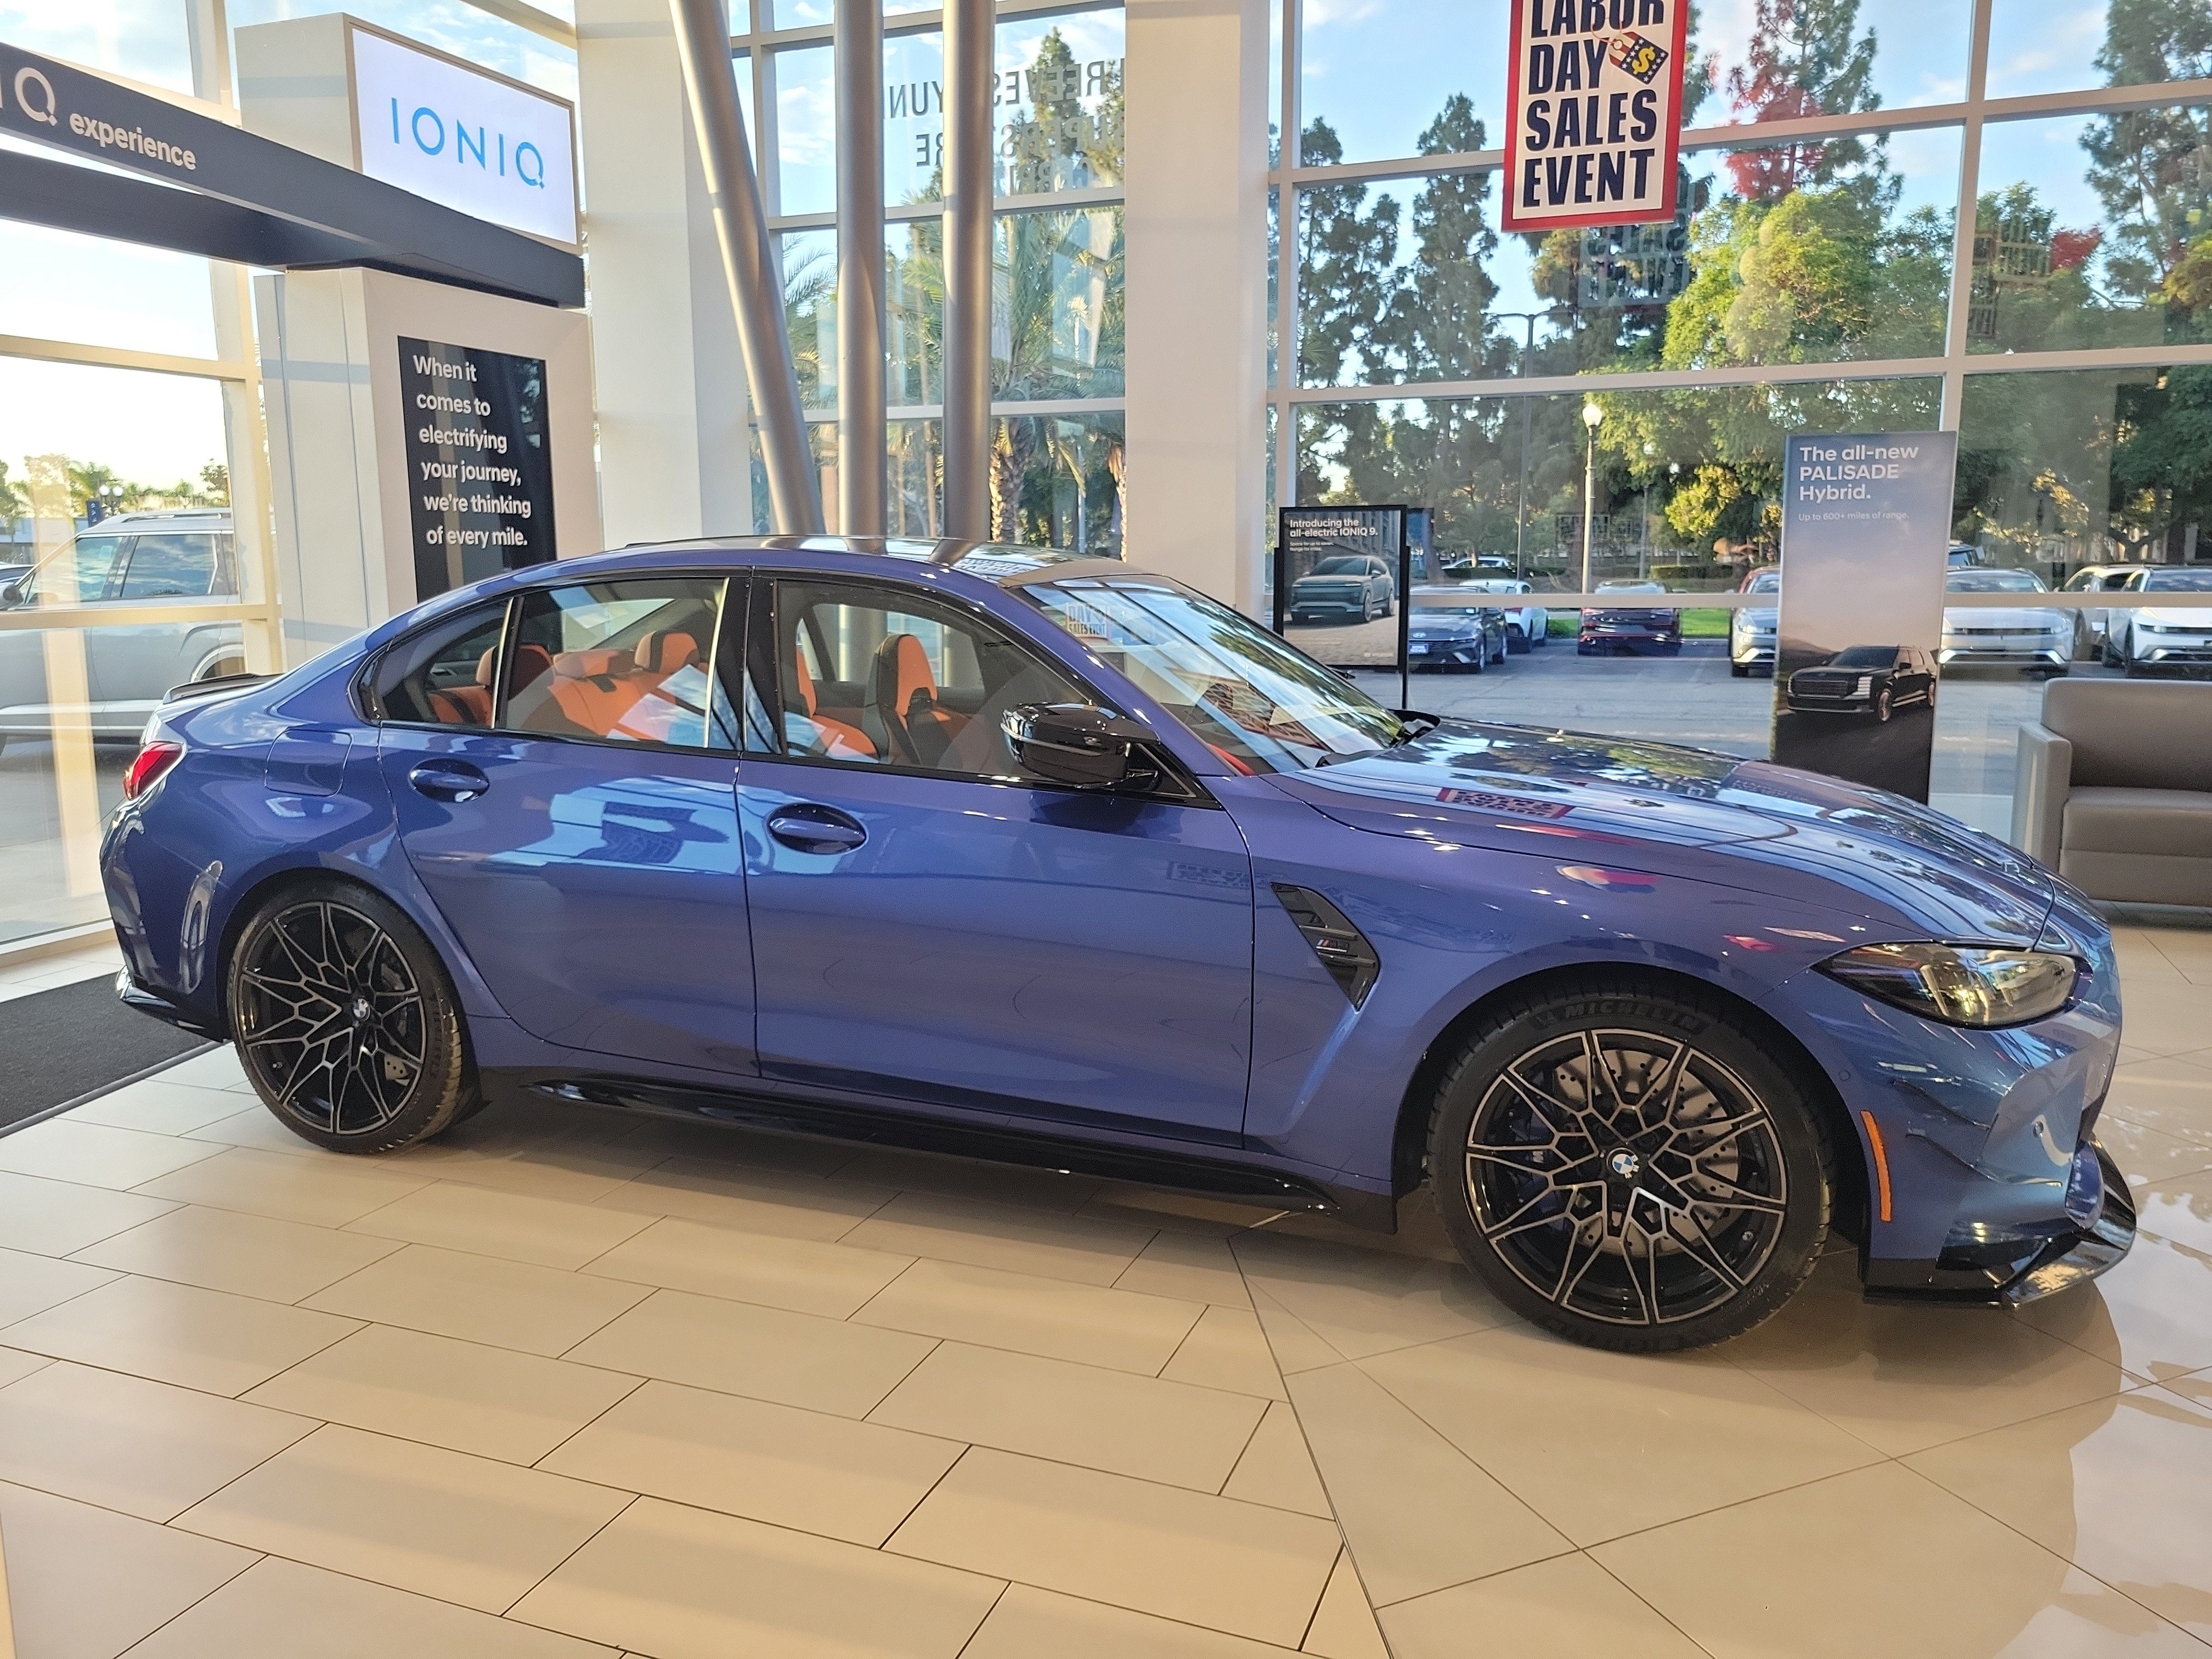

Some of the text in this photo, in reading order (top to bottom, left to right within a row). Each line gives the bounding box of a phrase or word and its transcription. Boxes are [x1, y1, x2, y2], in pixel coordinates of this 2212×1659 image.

[1531, 0, 1663, 38] LABOR
[1528, 37, 1610, 95] DAY
[0, 67, 196, 170] Q experience
[1526, 89, 1657, 151] SALES
[391, 97, 545, 190] IONIQ
[1522, 148, 1655, 208] EVENT
[413, 354, 477, 382] When it
[416, 393, 490, 416] comes to
[419, 425, 507, 454] electrifying
[1799, 445, 1919, 462] The all-new
[421, 460, 521, 487] your journey,
[1799, 464, 1899, 481] PALISADE
[424, 494, 532, 518] we're thinking
[1799, 484, 1871, 504] Hybrid.
[1290, 518, 1359, 528] Introducing the
[1882, 512, 1909, 521] range.
[426, 526, 528, 549] of every mile.
[1290, 527, 1378, 537] all-electric IONIQ 9.
